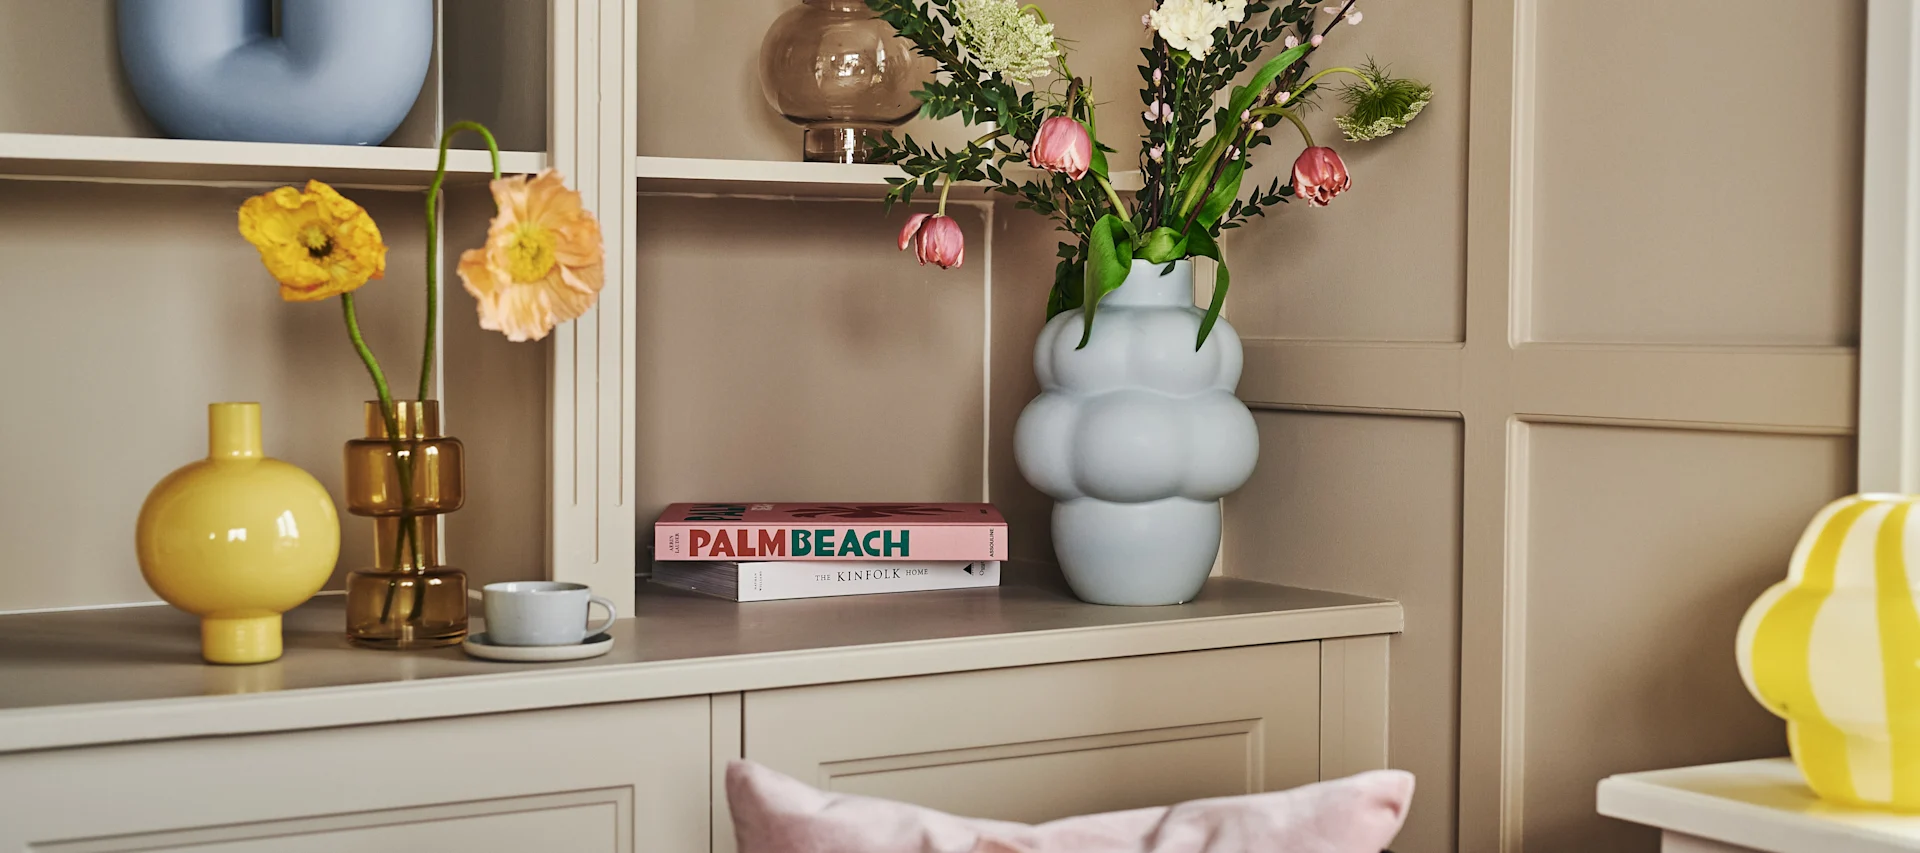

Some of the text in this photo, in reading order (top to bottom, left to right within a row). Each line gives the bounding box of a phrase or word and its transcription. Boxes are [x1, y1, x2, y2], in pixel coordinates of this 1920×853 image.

[814, 568, 929, 582] THE KINFOLK HOME
